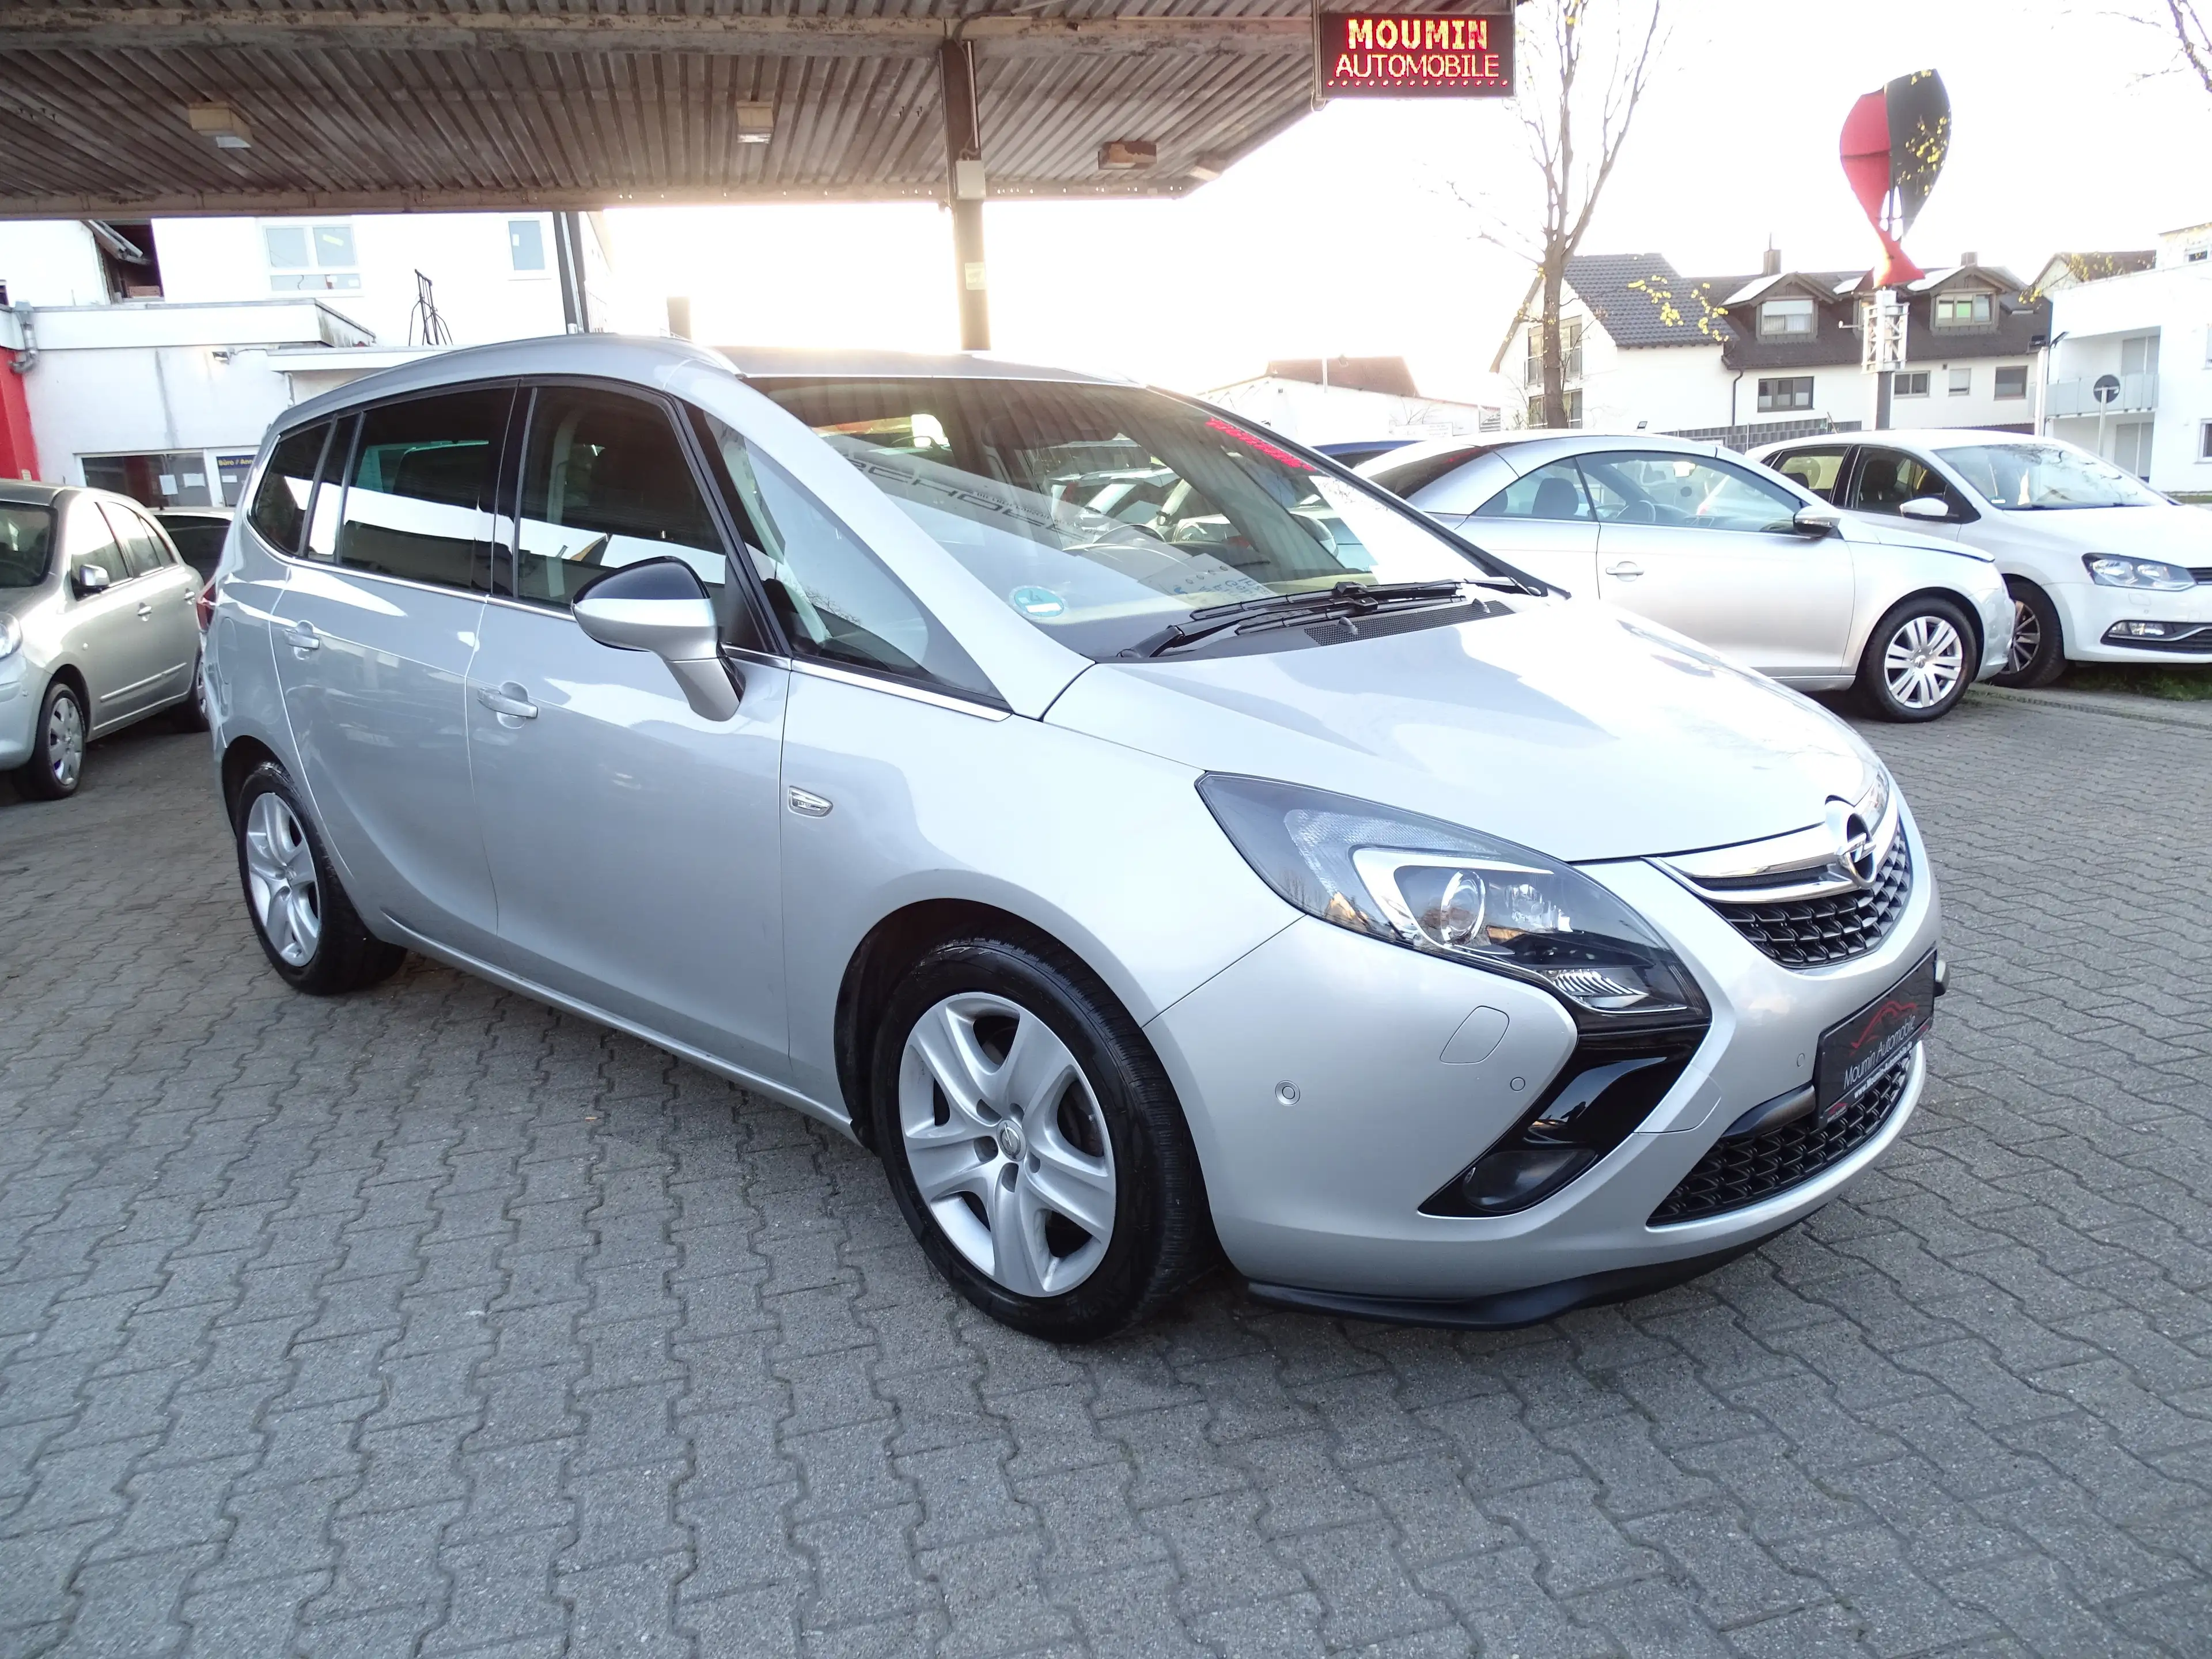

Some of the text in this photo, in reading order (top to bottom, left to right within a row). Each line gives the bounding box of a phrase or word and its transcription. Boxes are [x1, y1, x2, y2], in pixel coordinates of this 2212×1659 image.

[1347, 18, 1487, 50] MOUMIN
[1335, 54, 1499, 78] AUTOMOBILE
[1844, 1013, 1915, 1090] Moumin Automobile
